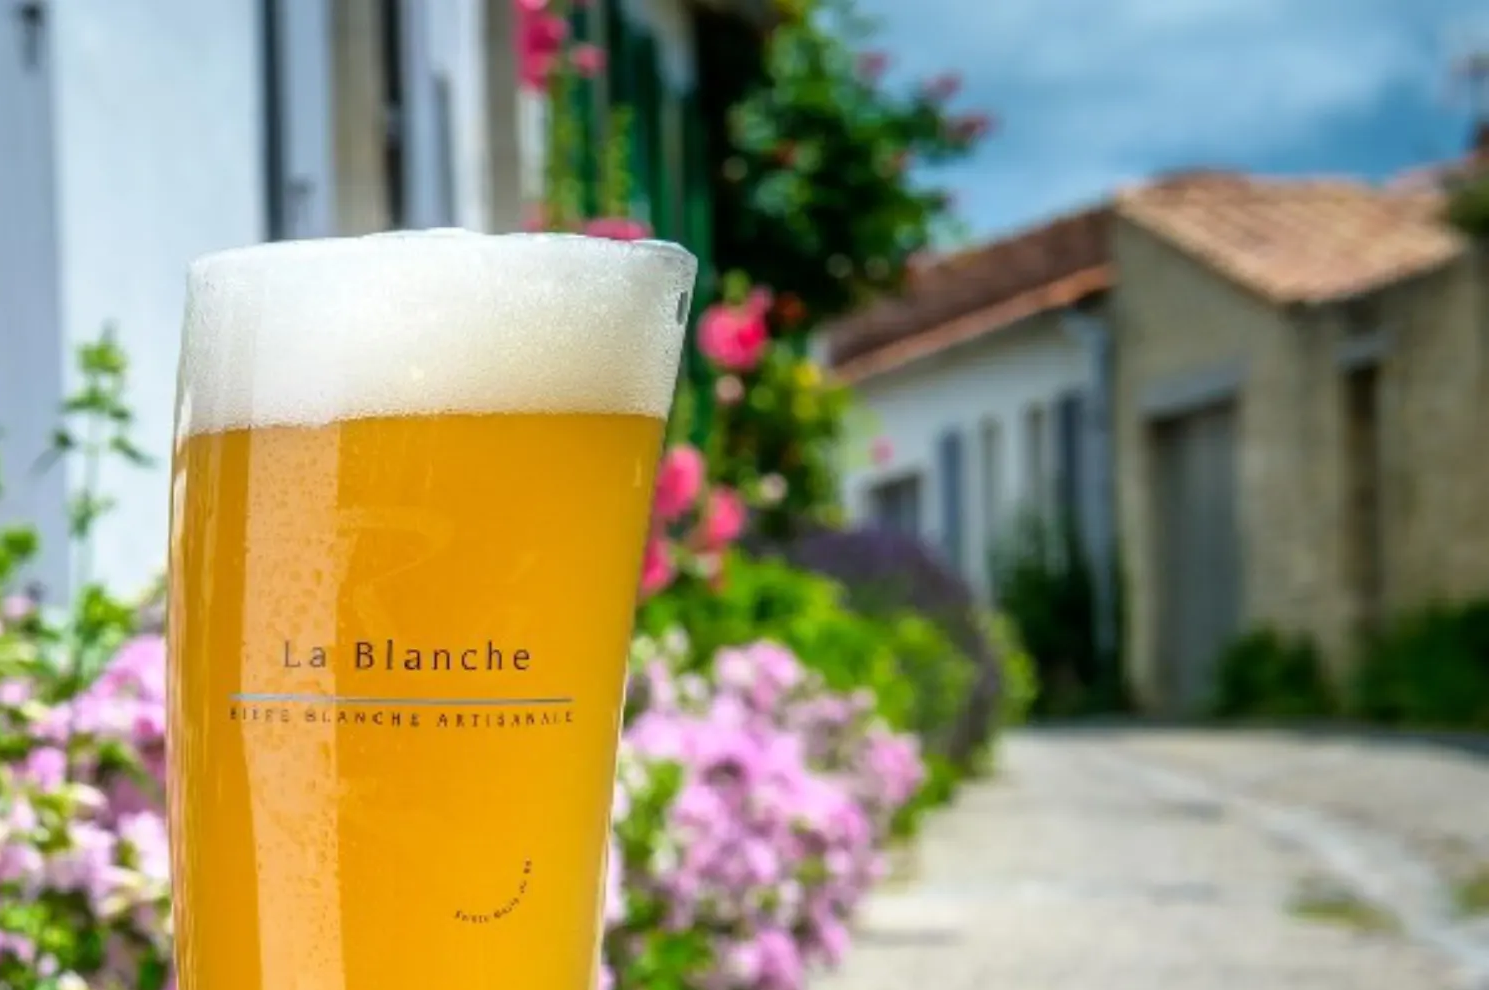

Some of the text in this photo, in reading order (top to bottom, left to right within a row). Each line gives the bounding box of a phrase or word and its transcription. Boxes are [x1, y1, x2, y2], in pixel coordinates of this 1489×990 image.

[283, 640, 532, 671] La Blanche
[304, 709, 420, 727] BLANCHE
